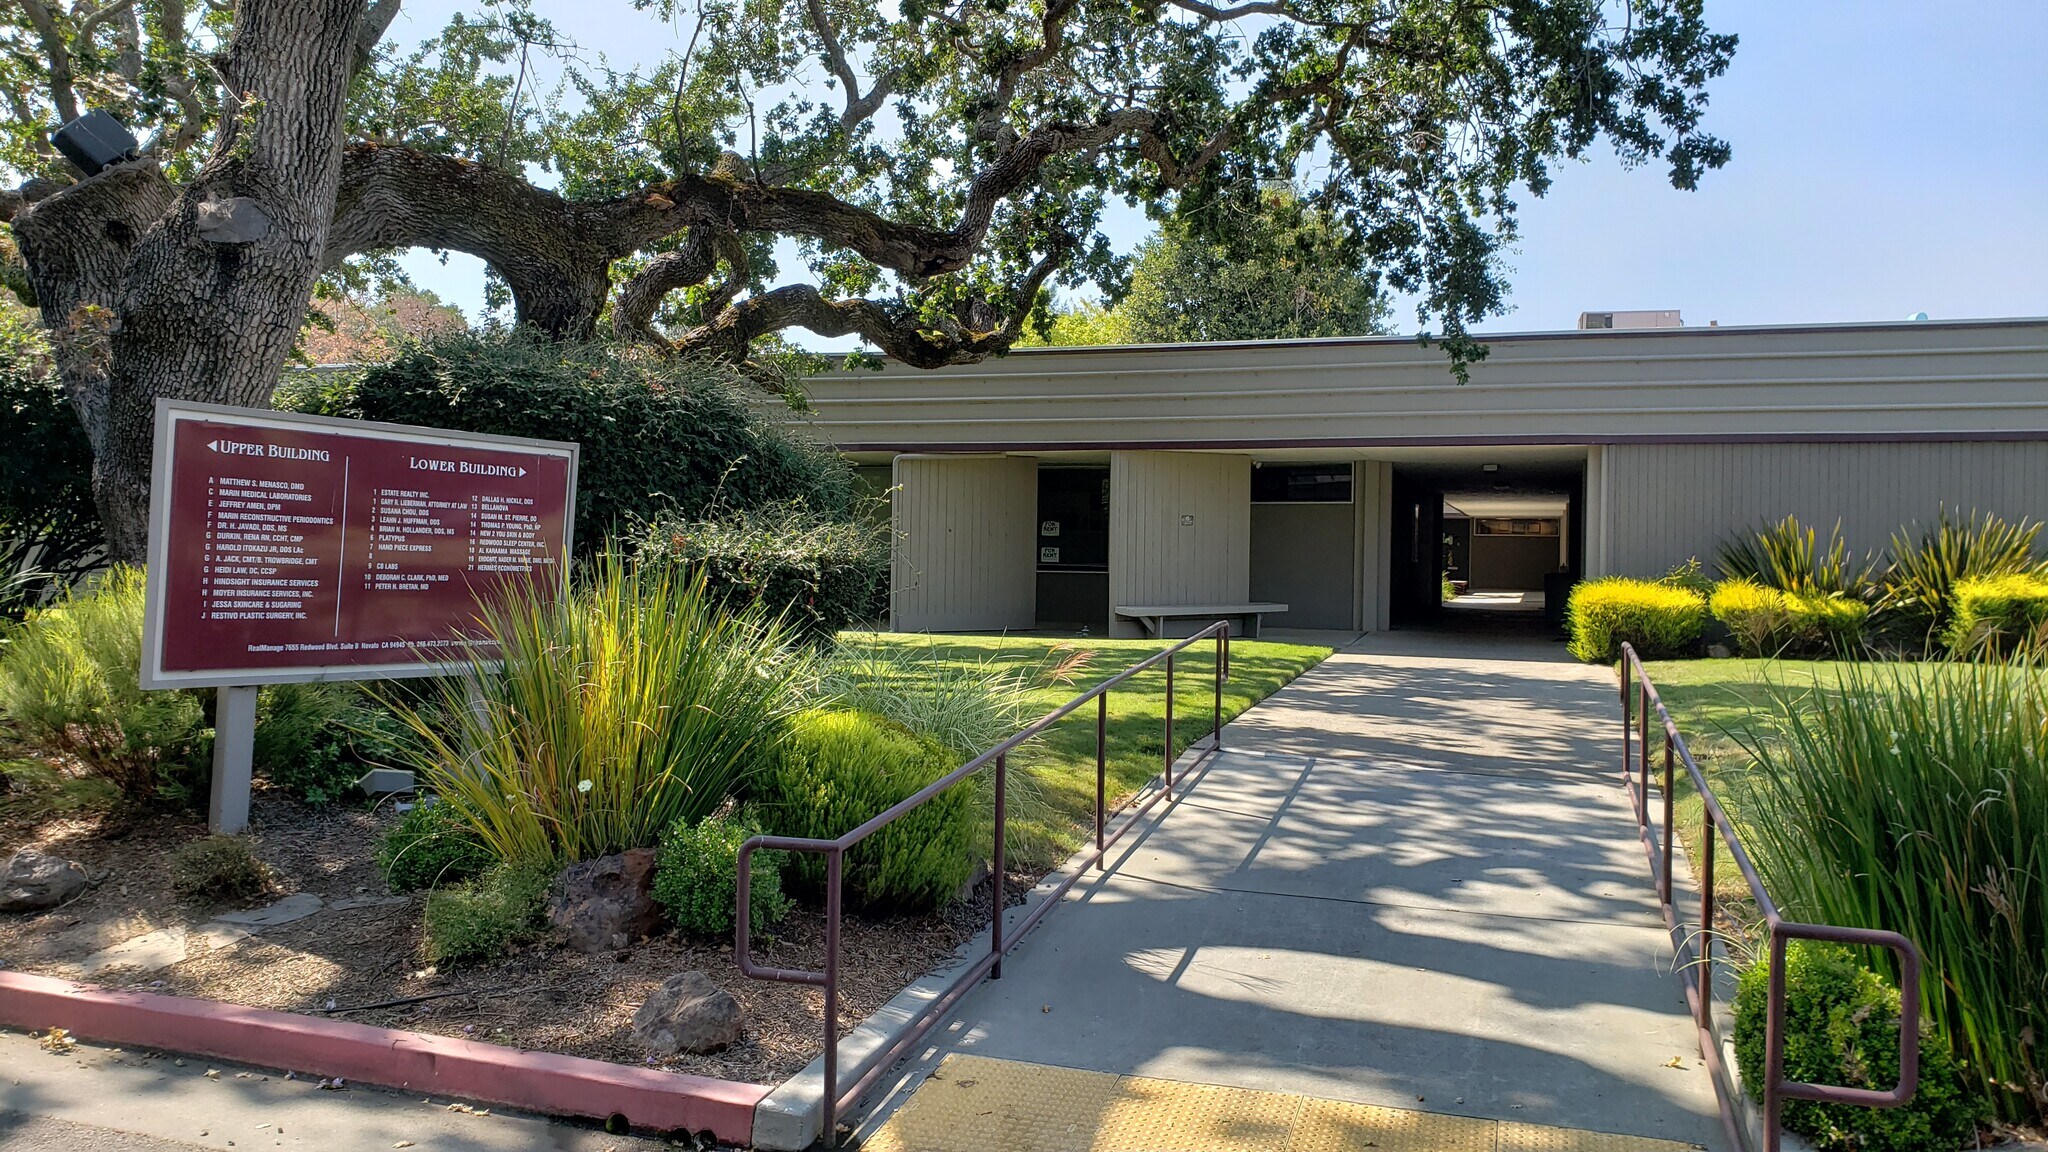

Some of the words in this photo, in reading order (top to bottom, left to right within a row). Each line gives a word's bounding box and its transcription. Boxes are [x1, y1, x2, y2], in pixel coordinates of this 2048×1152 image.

[220, 440, 264, 456] UPPER
[268, 445, 329, 461] BUILDING
[410, 457, 455, 472] LOWER
[460, 462, 516, 477] BUILDING
[220, 478, 250, 486] MATTHEW
[259, 481, 289, 490] MENASCO,
[269, 493, 312, 501] LABORATORIES
[240, 513, 292, 522] RECONSTRUCTIVE
[265, 557, 304, 566] TROWBRIDGE,
